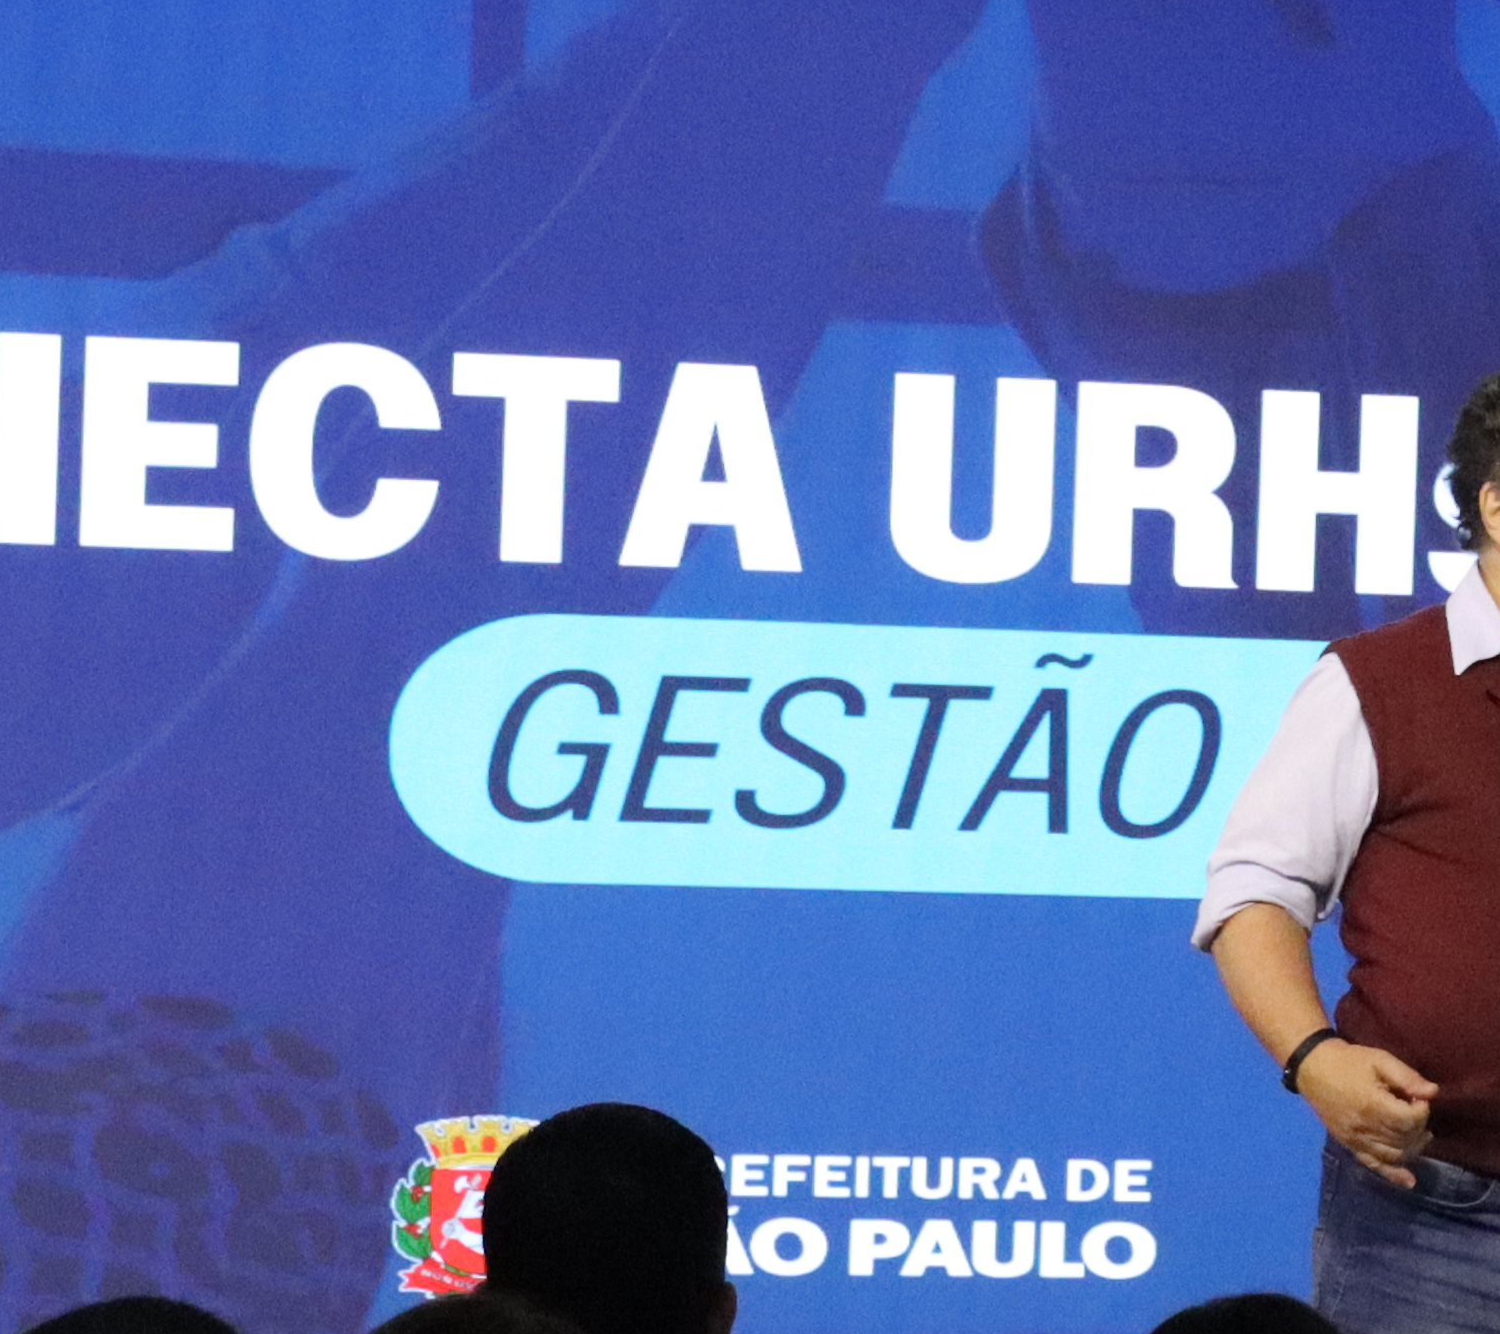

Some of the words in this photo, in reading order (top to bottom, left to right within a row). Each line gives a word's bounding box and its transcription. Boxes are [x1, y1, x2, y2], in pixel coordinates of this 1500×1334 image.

[486, 652, 1223, 839] GESTÃO
[714, 1153, 1047, 1201] EFEITURA
[1065, 1158, 1153, 1203] DE
[848, 1218, 1157, 1280] PAULO
